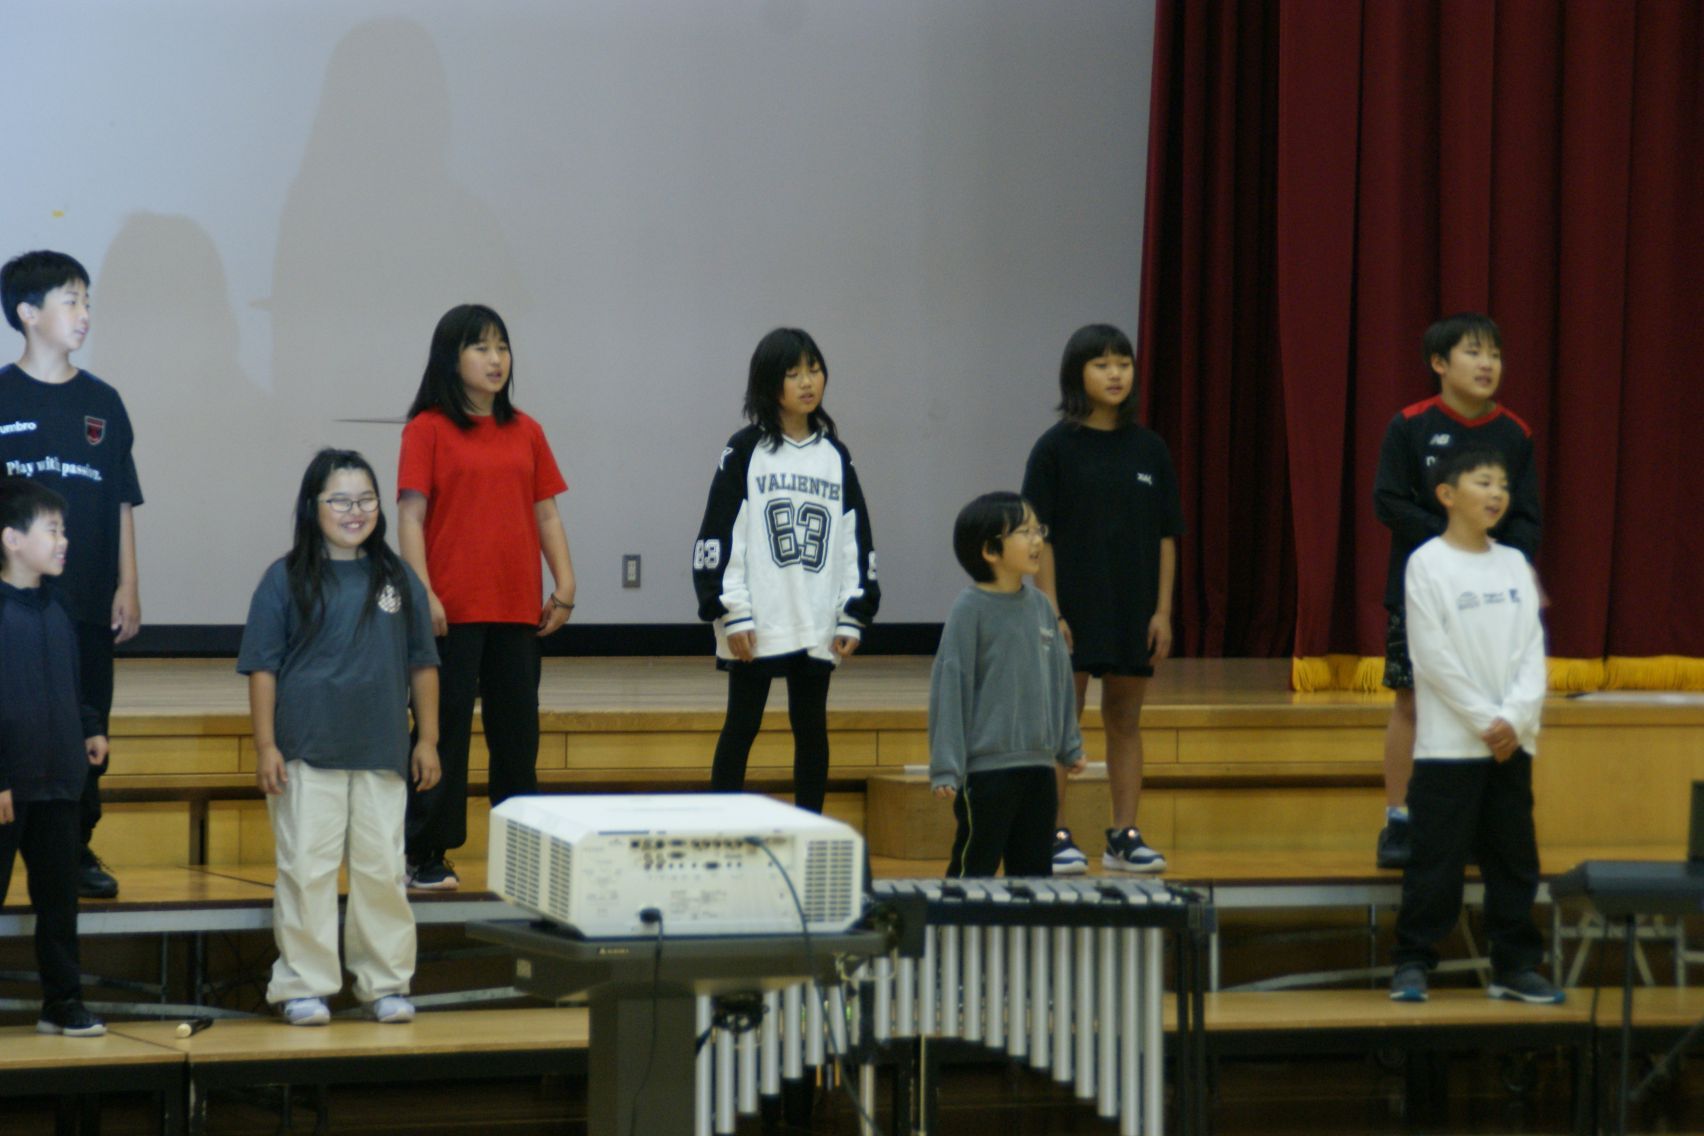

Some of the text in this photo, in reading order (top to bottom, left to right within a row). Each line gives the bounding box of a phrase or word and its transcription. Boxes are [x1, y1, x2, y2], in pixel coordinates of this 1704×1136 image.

[6, 460, 33, 477] Play
[756, 473, 841, 501] VALIENTE
[764, 497, 832, 573] 83
